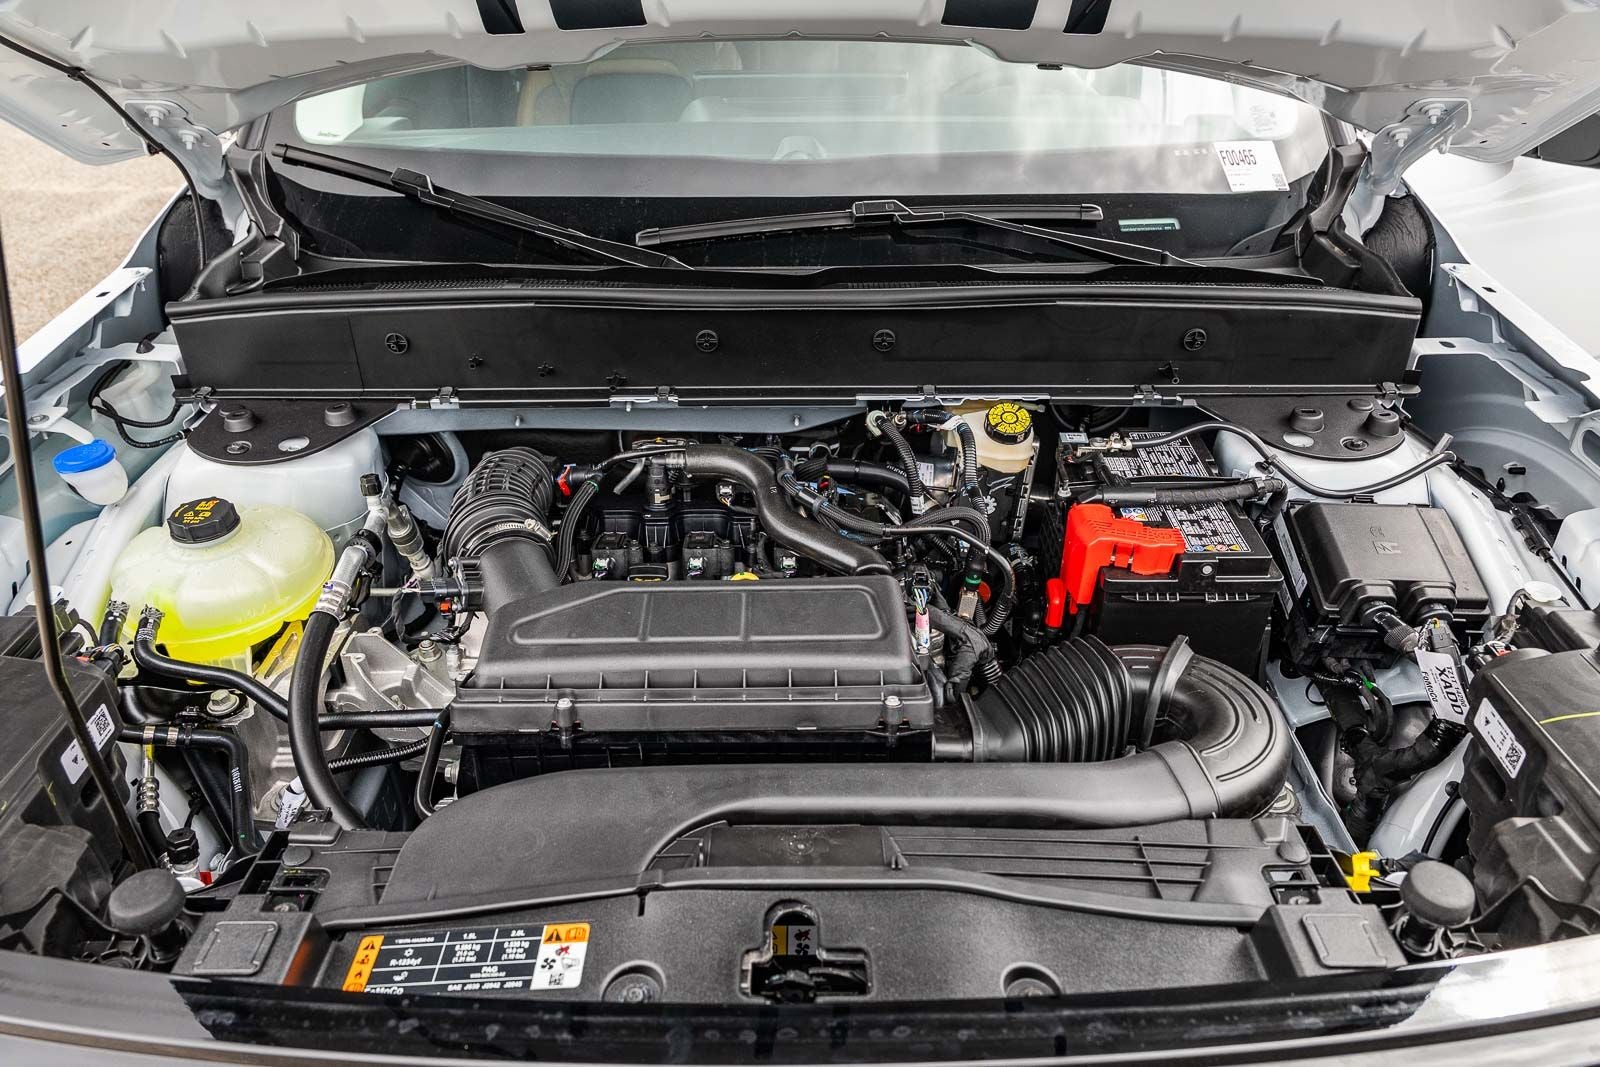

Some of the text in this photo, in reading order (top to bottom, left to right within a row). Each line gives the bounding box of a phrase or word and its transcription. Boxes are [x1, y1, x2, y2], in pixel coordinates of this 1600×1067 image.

[1219, 149, 1257, 166] F00465
[1421, 671, 1438, 703] FoMoCo
[389, 957, 422, 967] R-1234yf
